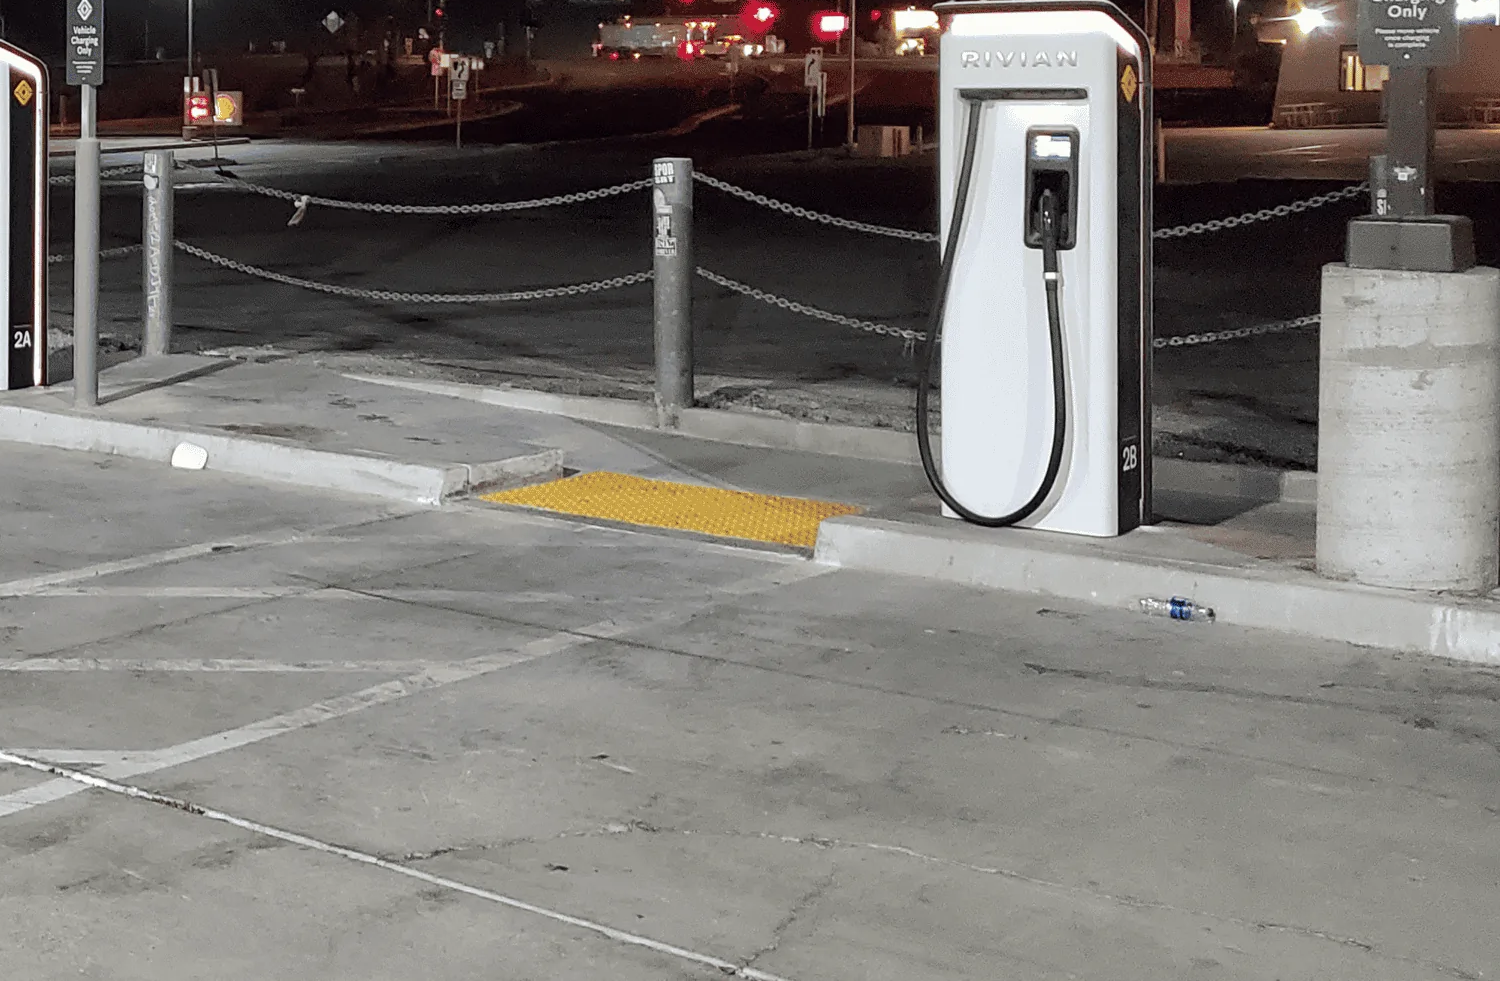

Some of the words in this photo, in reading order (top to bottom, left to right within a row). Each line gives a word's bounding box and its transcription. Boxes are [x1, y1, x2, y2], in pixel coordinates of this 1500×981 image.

[1387, 5, 1428, 21] Only
[73, 26, 97, 35] Vehicle
[71, 35, 99, 47] Charging
[77, 46, 92, 57] Only
[961, 50, 1078, 68] RIVIAN
[13, 330, 32, 349] 2A
[1122, 444, 1138, 472] 2B
